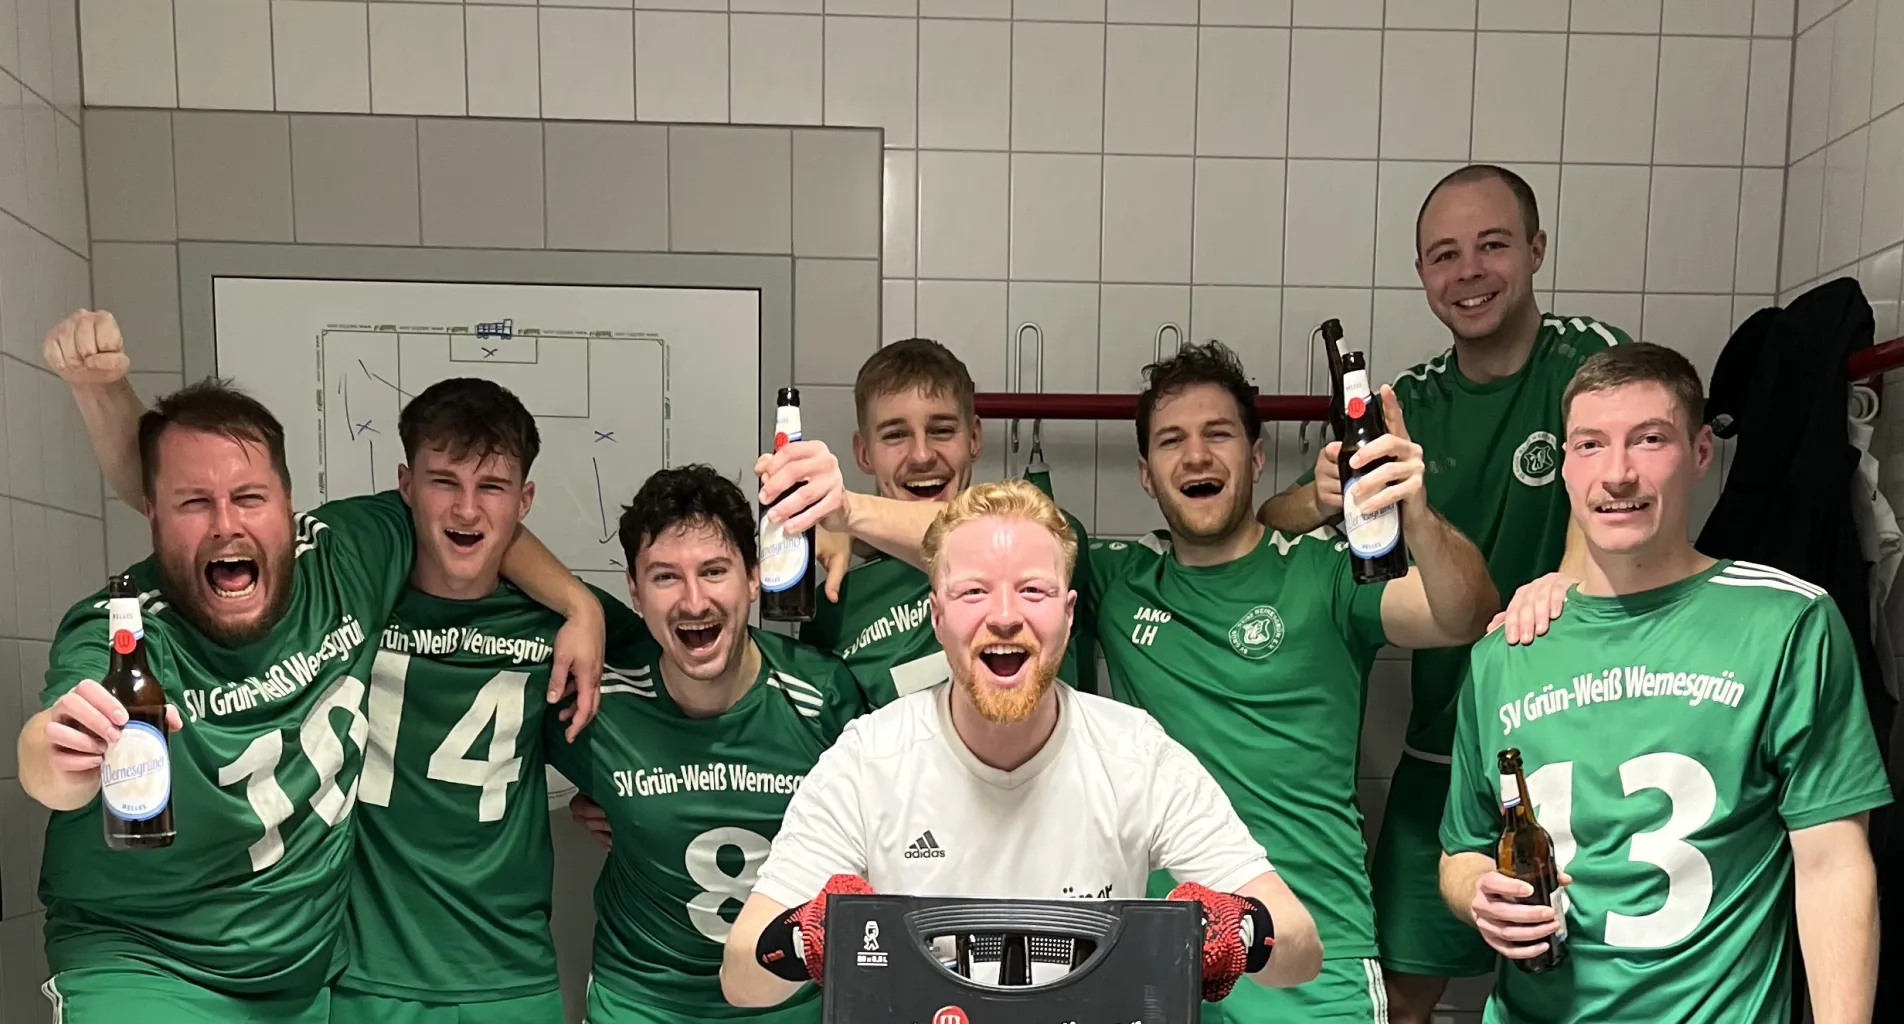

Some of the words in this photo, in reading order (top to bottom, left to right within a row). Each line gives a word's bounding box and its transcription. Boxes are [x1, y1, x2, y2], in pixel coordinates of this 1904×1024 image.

[1133, 606, 1171, 623] JAKO
[1131, 623, 1158, 646] LH
[183, 689, 206, 723] SV
[1499, 699, 1521, 736] SV
[1523, 667, 1623, 722] Grün-Weiß
[1624, 665, 1745, 708] Wernesgrün
[613, 771, 633, 797] SV
[635, 763, 728, 797] Grün-Weiß
[729, 764, 806, 795] Wernes
[904, 849, 946, 859] adidas
[685, 827, 772, 945] 8
